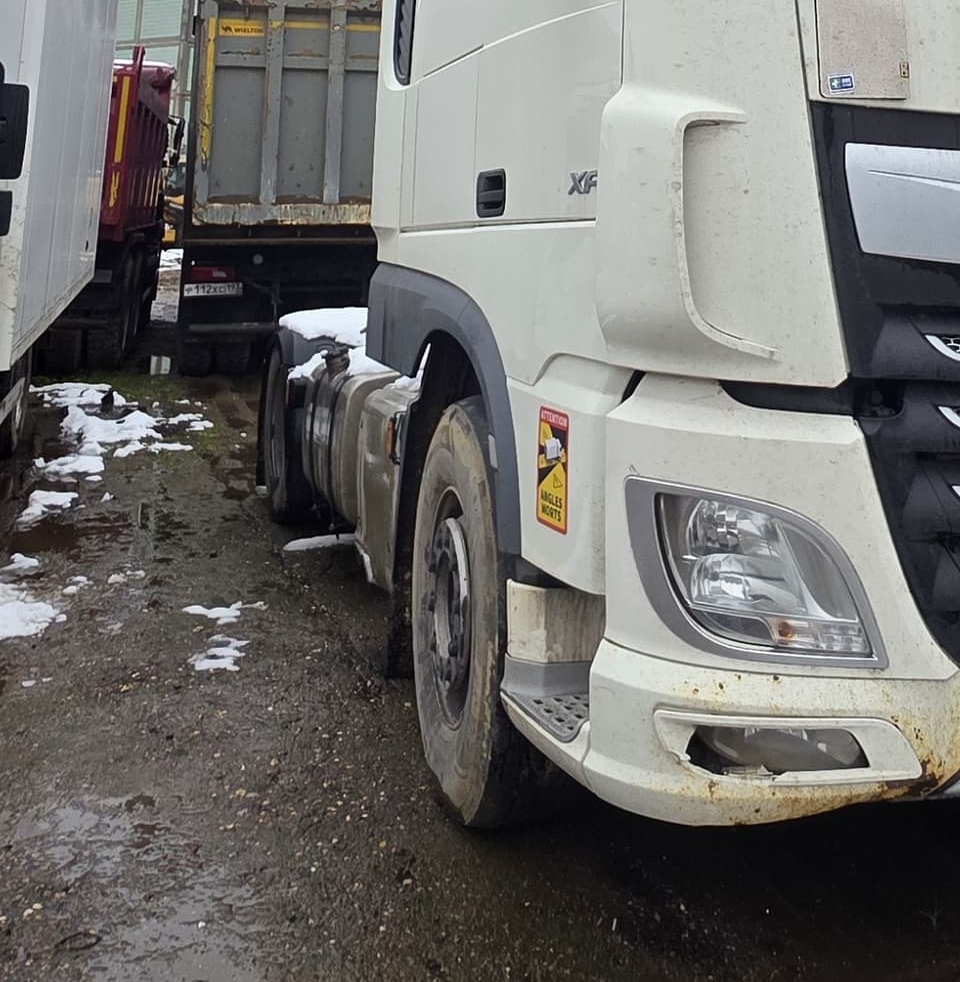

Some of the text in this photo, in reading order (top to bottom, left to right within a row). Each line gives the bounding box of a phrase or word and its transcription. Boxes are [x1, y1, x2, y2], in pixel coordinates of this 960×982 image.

[568, 170, 598, 195] XF
[541, 489, 563, 509] ANGLES
[541, 503, 561, 522] MORTS
